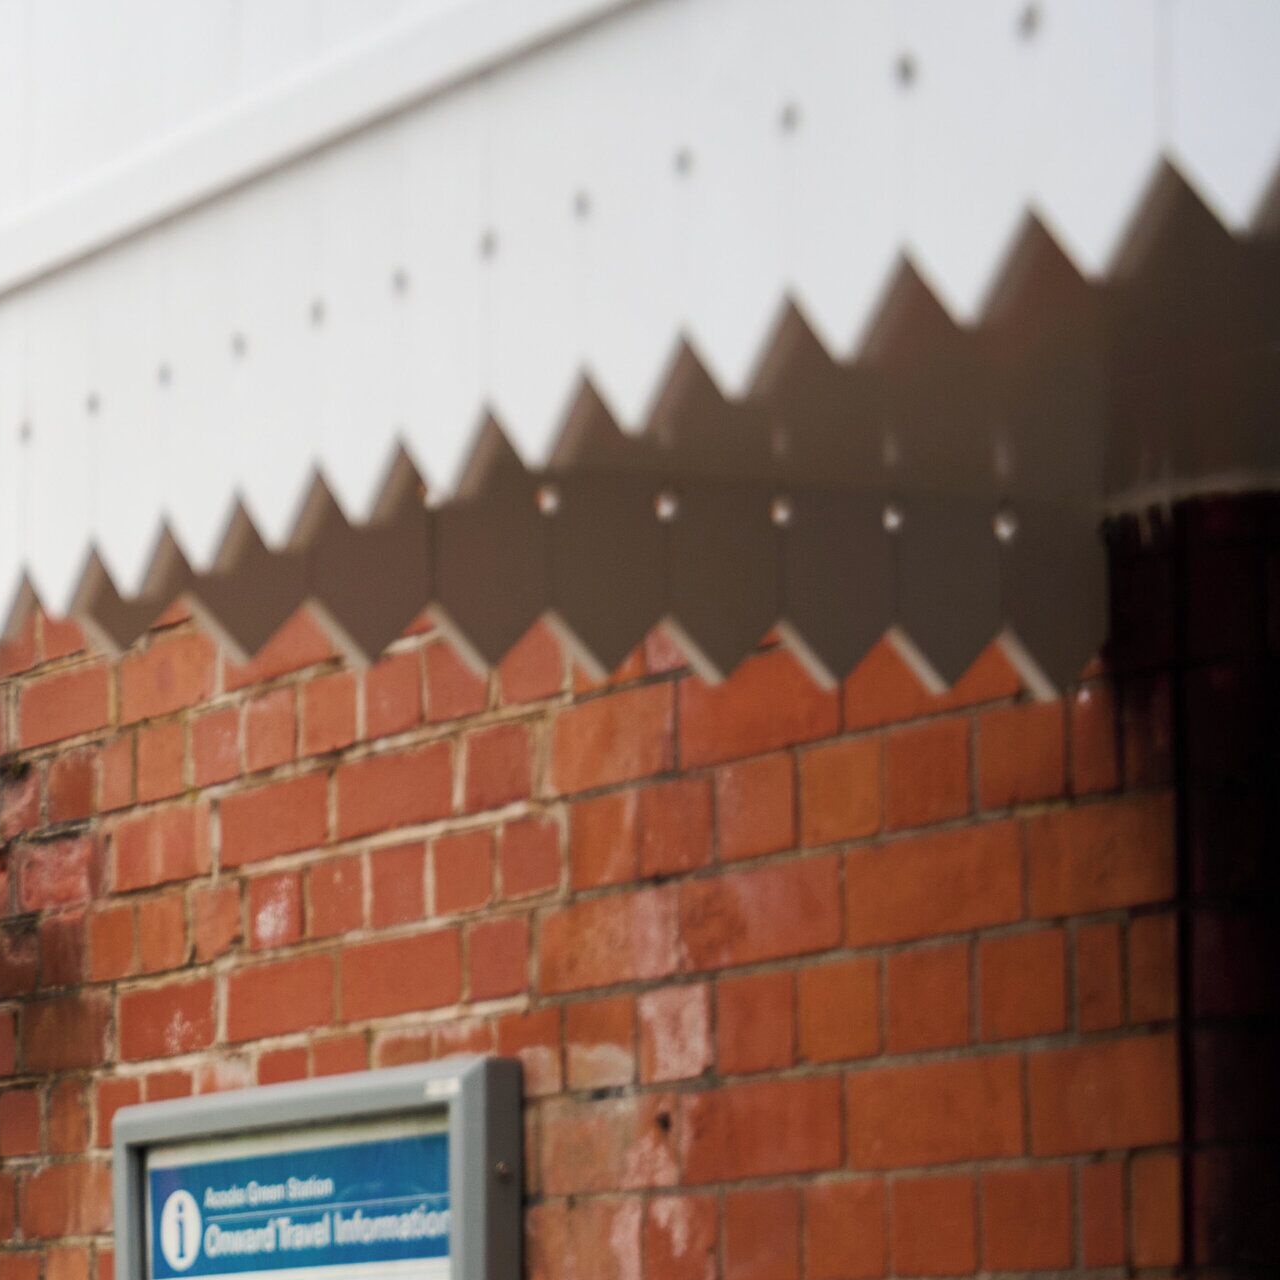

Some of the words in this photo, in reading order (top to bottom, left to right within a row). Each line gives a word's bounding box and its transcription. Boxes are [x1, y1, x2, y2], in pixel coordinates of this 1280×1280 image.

[287, 1176, 334, 1201] Station
[204, 1217, 277, 1259] Onward
[277, 1211, 331, 1251] Travel
